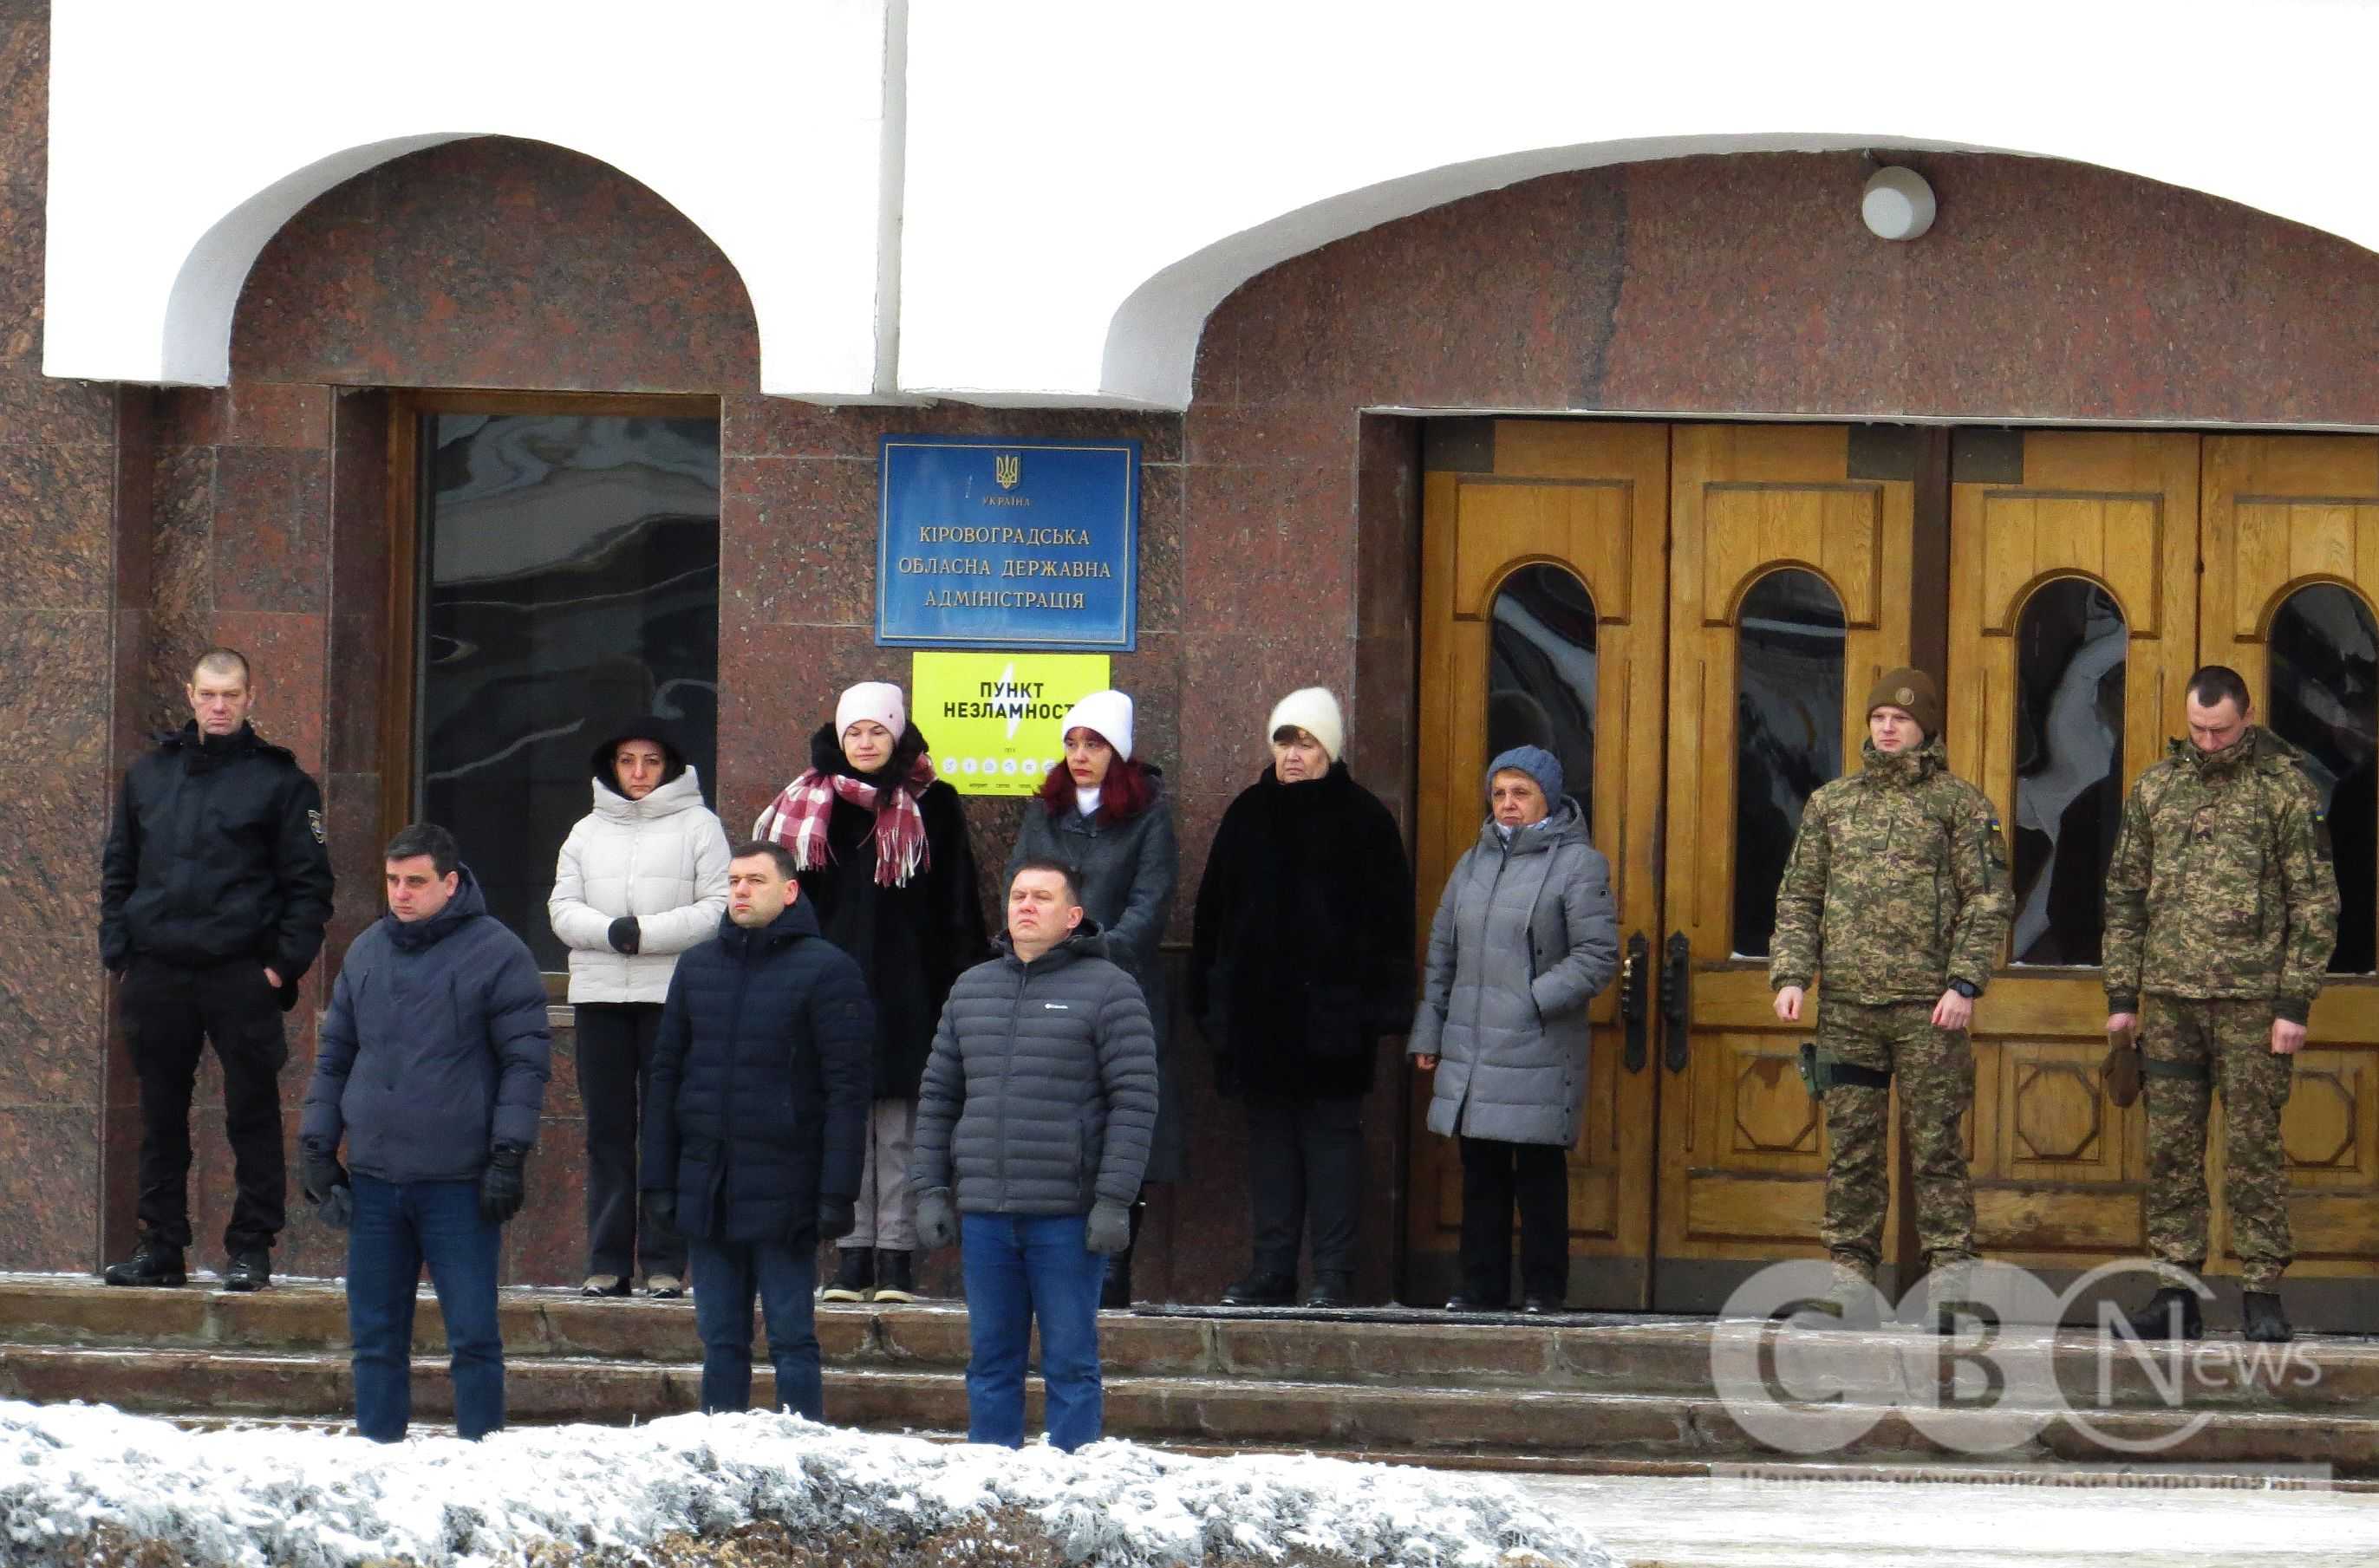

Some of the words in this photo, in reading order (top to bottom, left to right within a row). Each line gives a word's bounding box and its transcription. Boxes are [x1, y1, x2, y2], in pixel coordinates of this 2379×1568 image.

[919, 525, 1090, 546] КІРОВОГРАДСЬКА
[898, 557, 991, 576] ОБЛАСНА
[1000, 559, 1111, 578] ДЕРЖАВНА
[925, 590, 1085, 609] АДМІНІСТРАЦІЯ
[980, 681, 1044, 699] ПУНКТ
[943, 702, 1075, 719] НЕЗЛАМНОСТ
